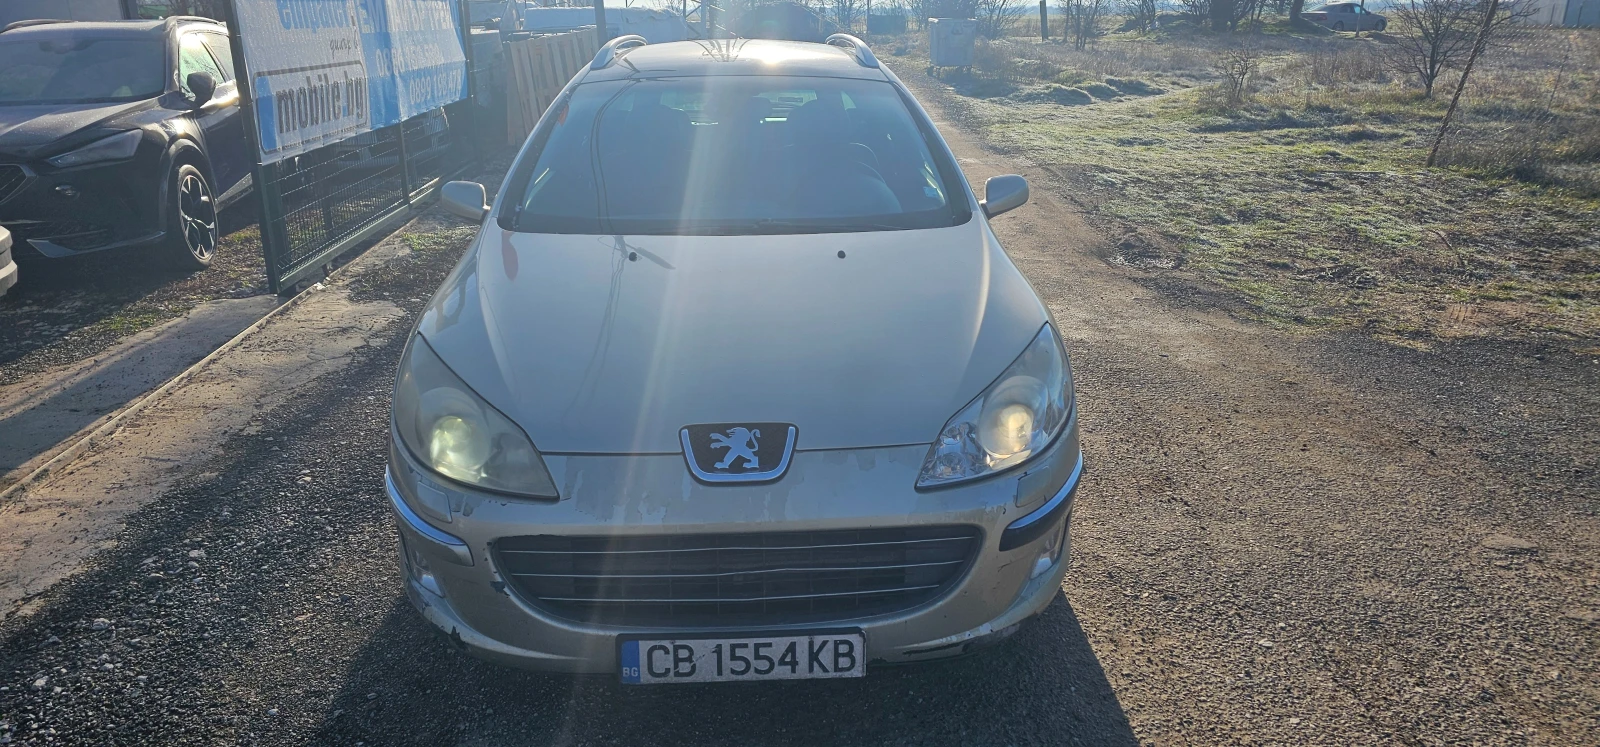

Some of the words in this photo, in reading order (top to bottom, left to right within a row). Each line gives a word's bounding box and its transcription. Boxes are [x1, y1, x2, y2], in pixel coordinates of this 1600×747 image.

[276, 70, 366, 134] mobile.bg
[622, 666, 639, 678] BG
[646, 643, 697, 678] CB
[711, 640, 799, 677] 1554
[808, 639, 856, 674] KB
